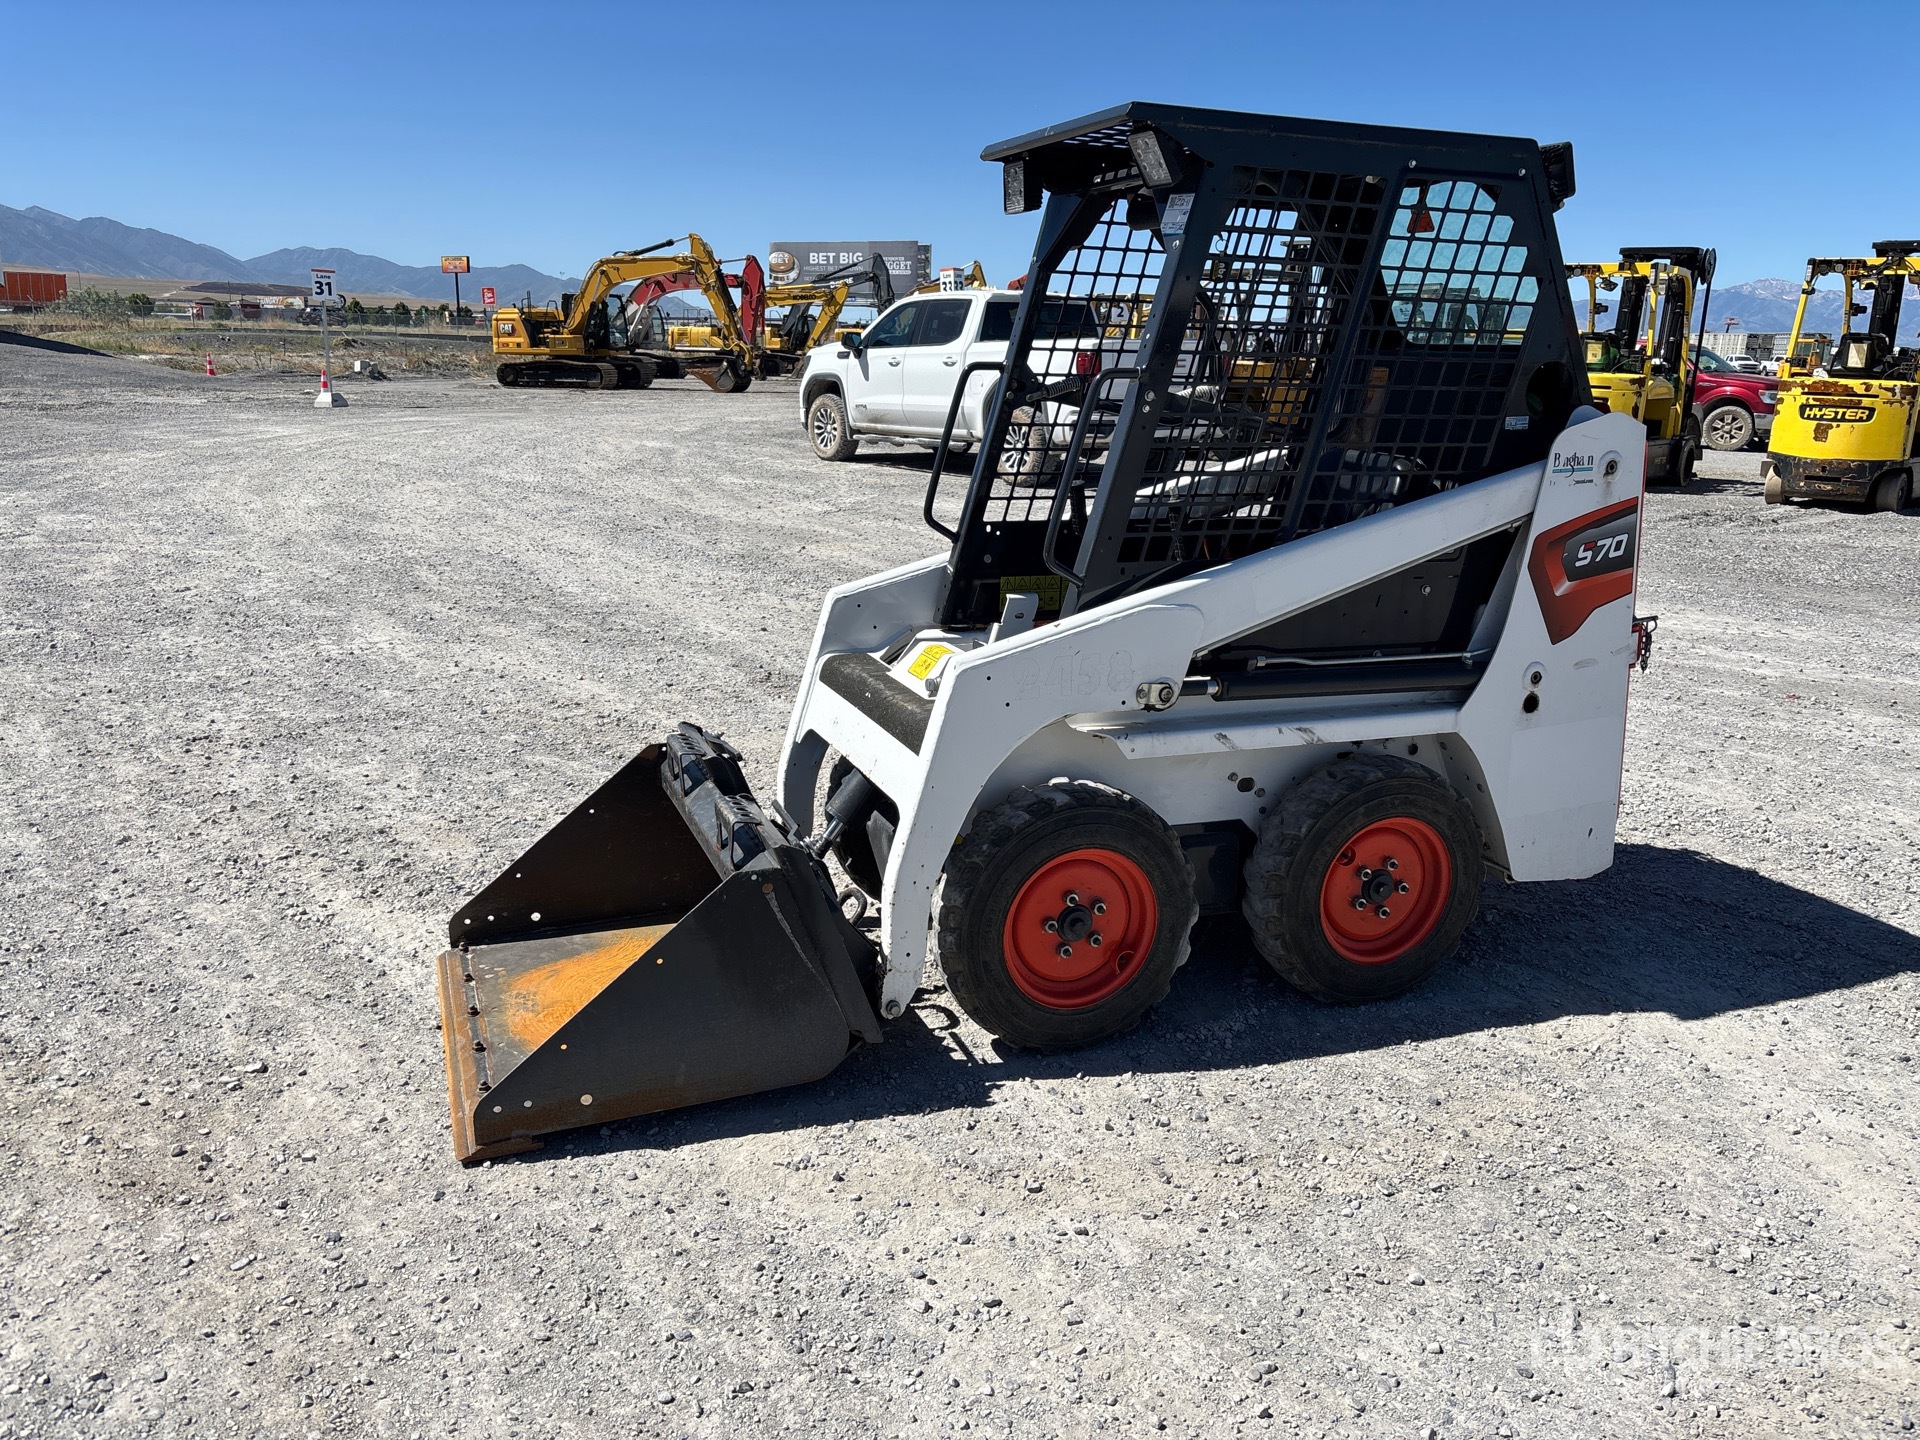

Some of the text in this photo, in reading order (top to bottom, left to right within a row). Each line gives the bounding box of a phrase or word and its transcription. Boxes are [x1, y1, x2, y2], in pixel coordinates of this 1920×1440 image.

[809, 252, 863, 264] BET BIG
[885, 261, 911, 270] GGET
[314, 281, 332, 297] 31
[499, 324, 513, 333] CAT
[1804, 407, 1869, 420] HYSTER
[1575, 534, 1628, 567] S70
